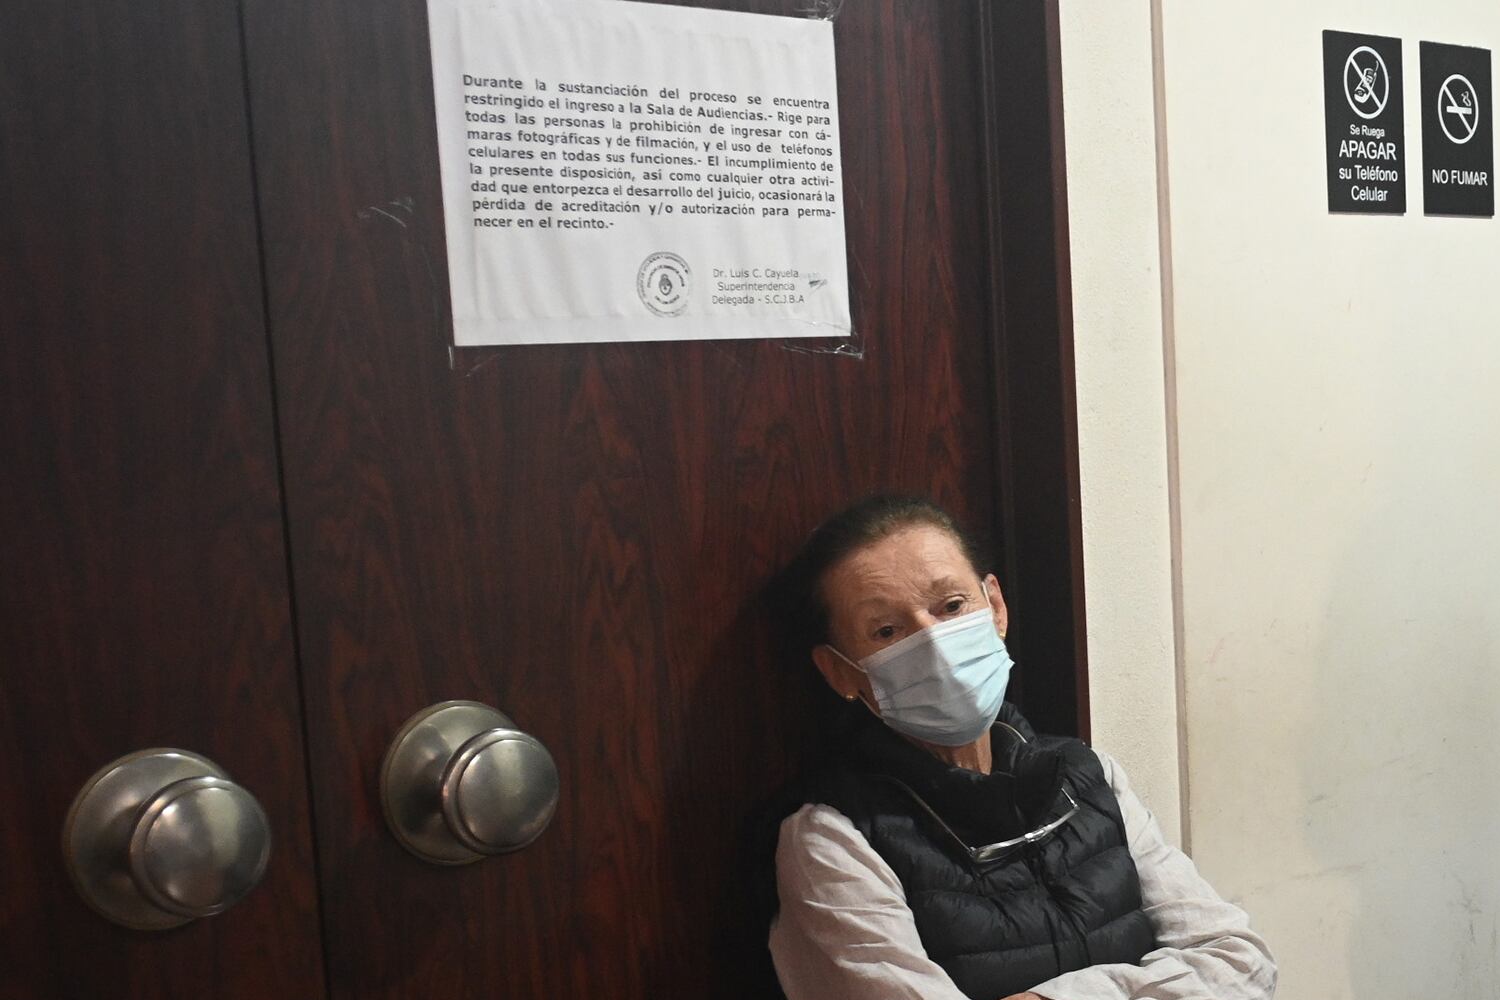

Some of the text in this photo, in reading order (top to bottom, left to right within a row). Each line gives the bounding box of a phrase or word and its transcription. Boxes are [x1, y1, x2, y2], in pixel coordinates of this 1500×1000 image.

[463, 74, 830, 109] Durante la sustanciación del proceso se encuentra
[464, 94, 830, 126] restringido el ingreso a la Sala de Audiencias.- Rige para
[465, 111, 831, 140] todas las personas la prohibición de ingresar con cá-
[1350, 124, 1385, 139] Se Ruega
[467, 130, 832, 156] maras fotográficas y de filmación, y el uso de teléfonos
[1339, 140, 1396, 160] APAGAR
[468, 147, 833, 171] celulares en todas sus funciones.- El incumplimiento de
[470, 163, 834, 186] la presente disposición, así como cualquier otra activi-
[1339, 165, 1398, 182] su Teléfono
[1432, 170, 1487, 185] NO FUMAR
[471, 181, 835, 201] dad que entorpezca el desarrollo del juicio, ocasionará la
[1351, 186, 1388, 201] Celular
[472, 198, 835, 218] pérdida de acreditación y/o autorización para perma-
[474, 217, 614, 229] necer en el recinto.-
[731, 269, 749, 278] Luis
